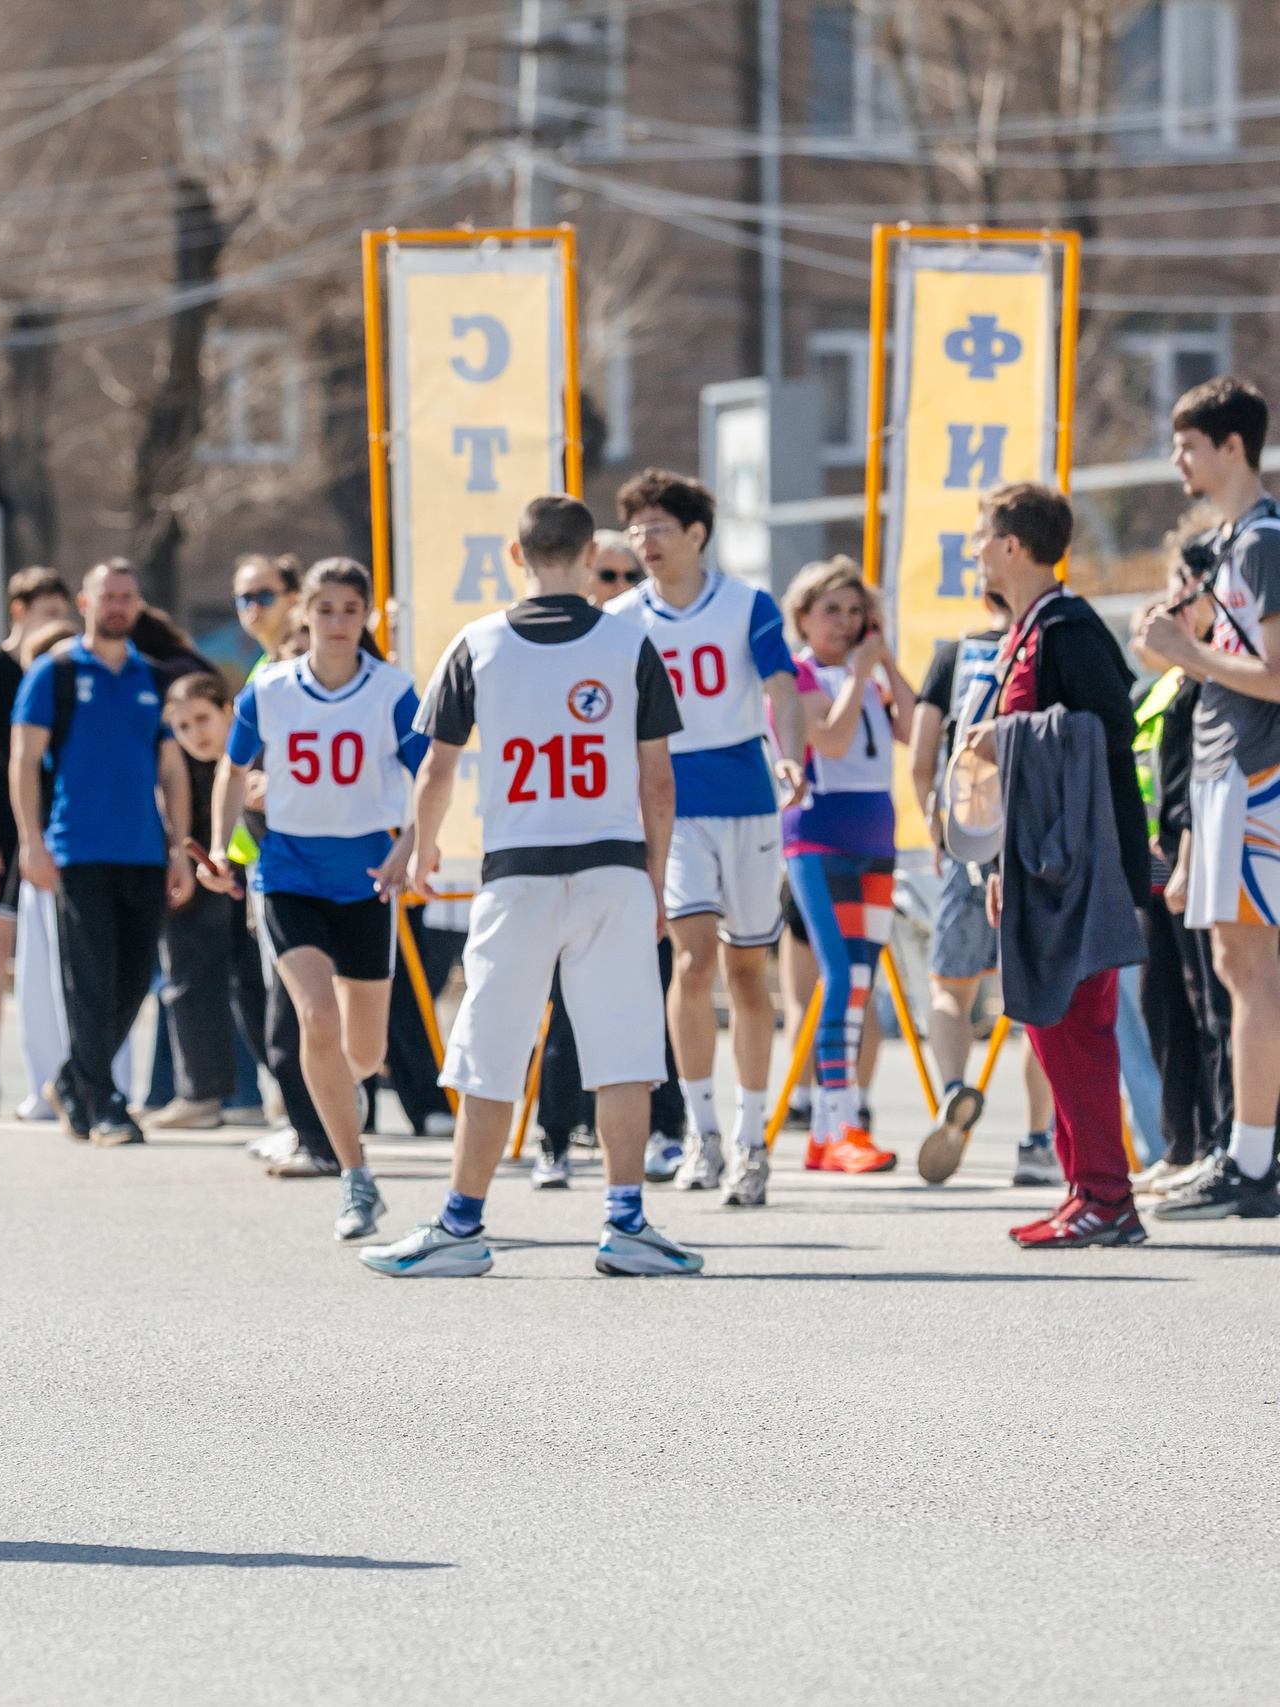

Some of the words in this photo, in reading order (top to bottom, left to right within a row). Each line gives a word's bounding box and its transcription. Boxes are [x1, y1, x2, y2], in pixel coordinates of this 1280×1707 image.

[934, 314, 1024, 655] ФИН
[288, 731, 364, 785] 50
[503, 734, 607, 803] 215
